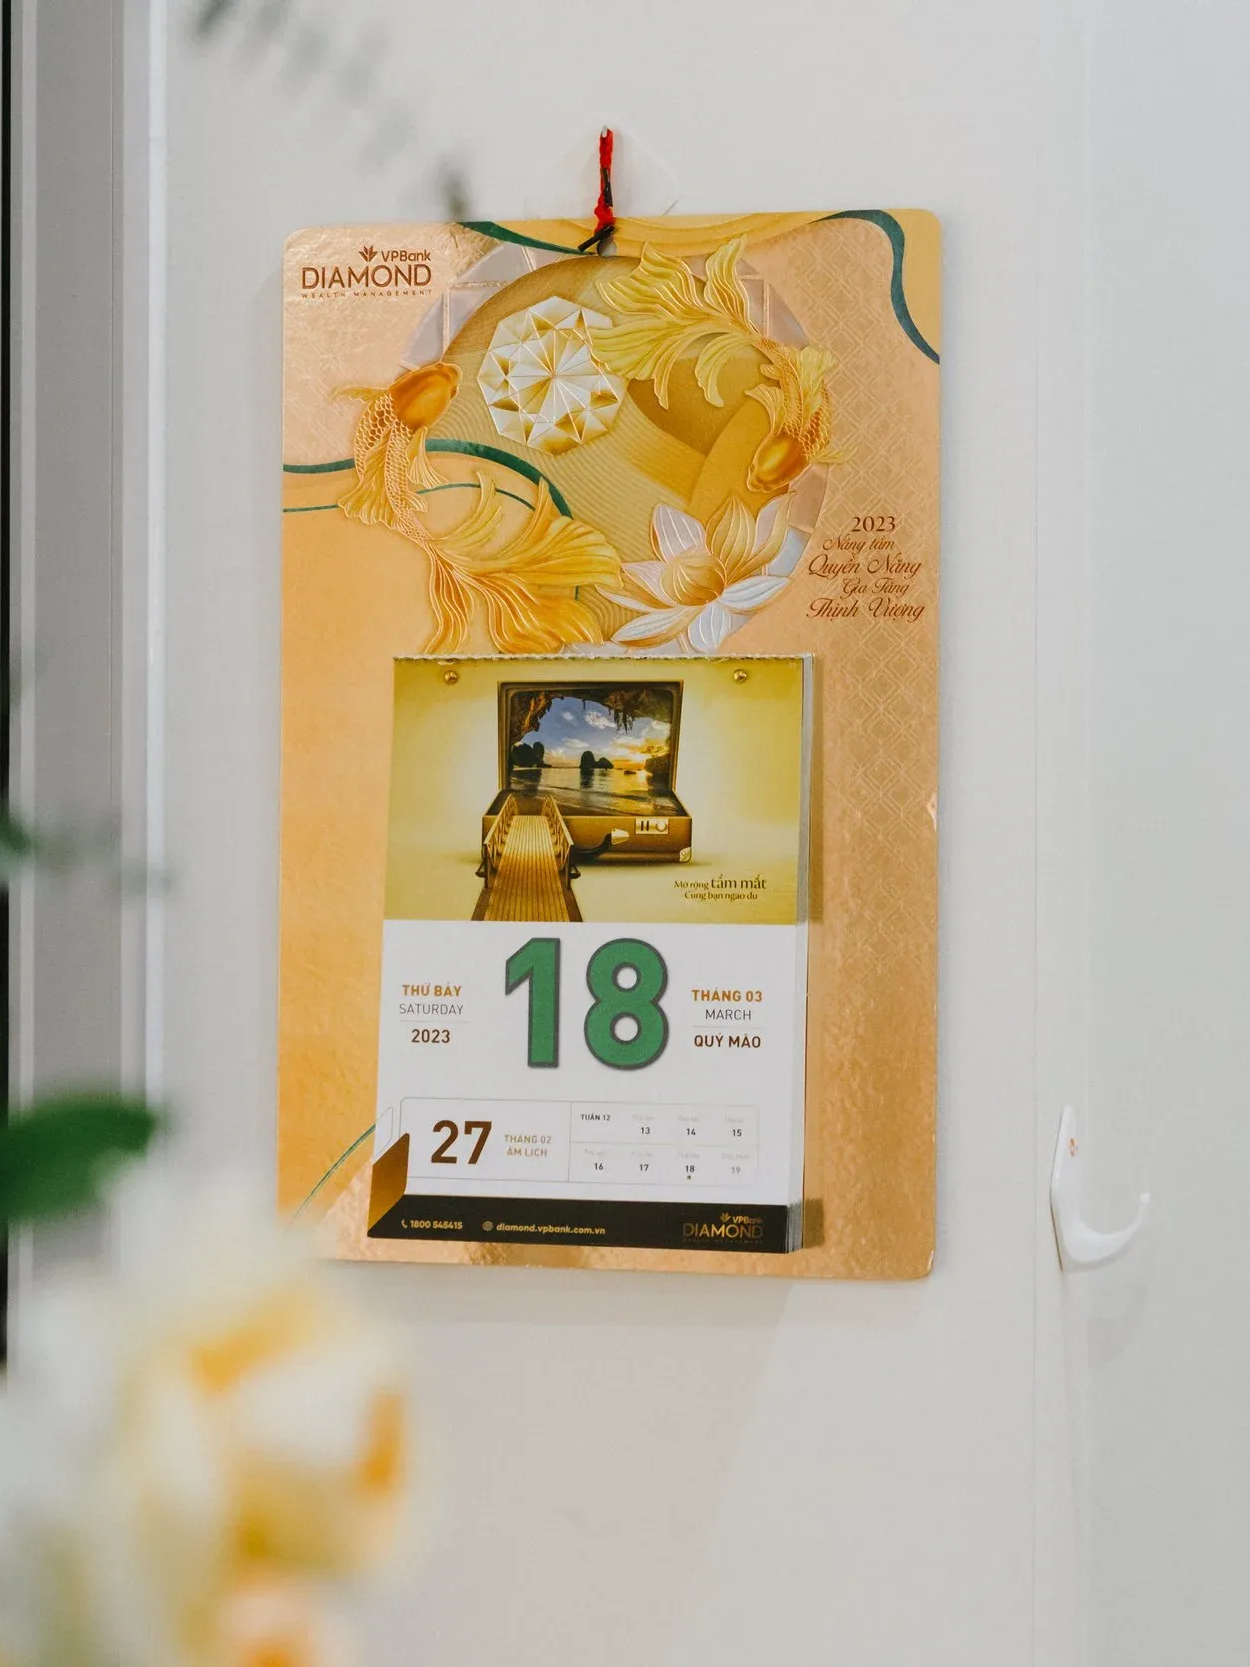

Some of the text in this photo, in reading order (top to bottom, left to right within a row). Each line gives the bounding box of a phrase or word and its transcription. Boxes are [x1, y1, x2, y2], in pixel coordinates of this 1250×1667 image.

[381, 249, 432, 262] VPBank
[301, 263, 432, 290] DIAMOND
[301, 289, 432, 299] WEALTH MANAGEMENT
[851, 515, 896, 532] 2023
[840, 577, 868, 599] Gia
[725, 893, 746, 902] ngao
[746, 891, 759, 900] du
[745, 990, 763, 1002] 03
[399, 1002, 464, 1016] SATURDAY
[505, 937, 670, 1071] 18
[705, 1008, 752, 1021] MARCH
[411, 1028, 451, 1044] 2023
[602, 1113, 611, 1122] 12
[640, 1126, 651, 1135] 13
[686, 1127, 696, 1136] 14
[731, 1128, 742, 1137] 15
[431, 1119, 492, 1165] 27
[540, 1135, 552, 1145] 02
[594, 1162, 604, 1171] 16
[639, 1163, 650, 1172] 17
[685, 1164, 695, 1173] 18
[730, 1166, 741, 1175] 19
[410, 1219, 463, 1230] 1800 545415
[496, 1223, 606, 1235] diamond.vpbank.com.vn
[682, 1222, 764, 1238] DIAMOND
